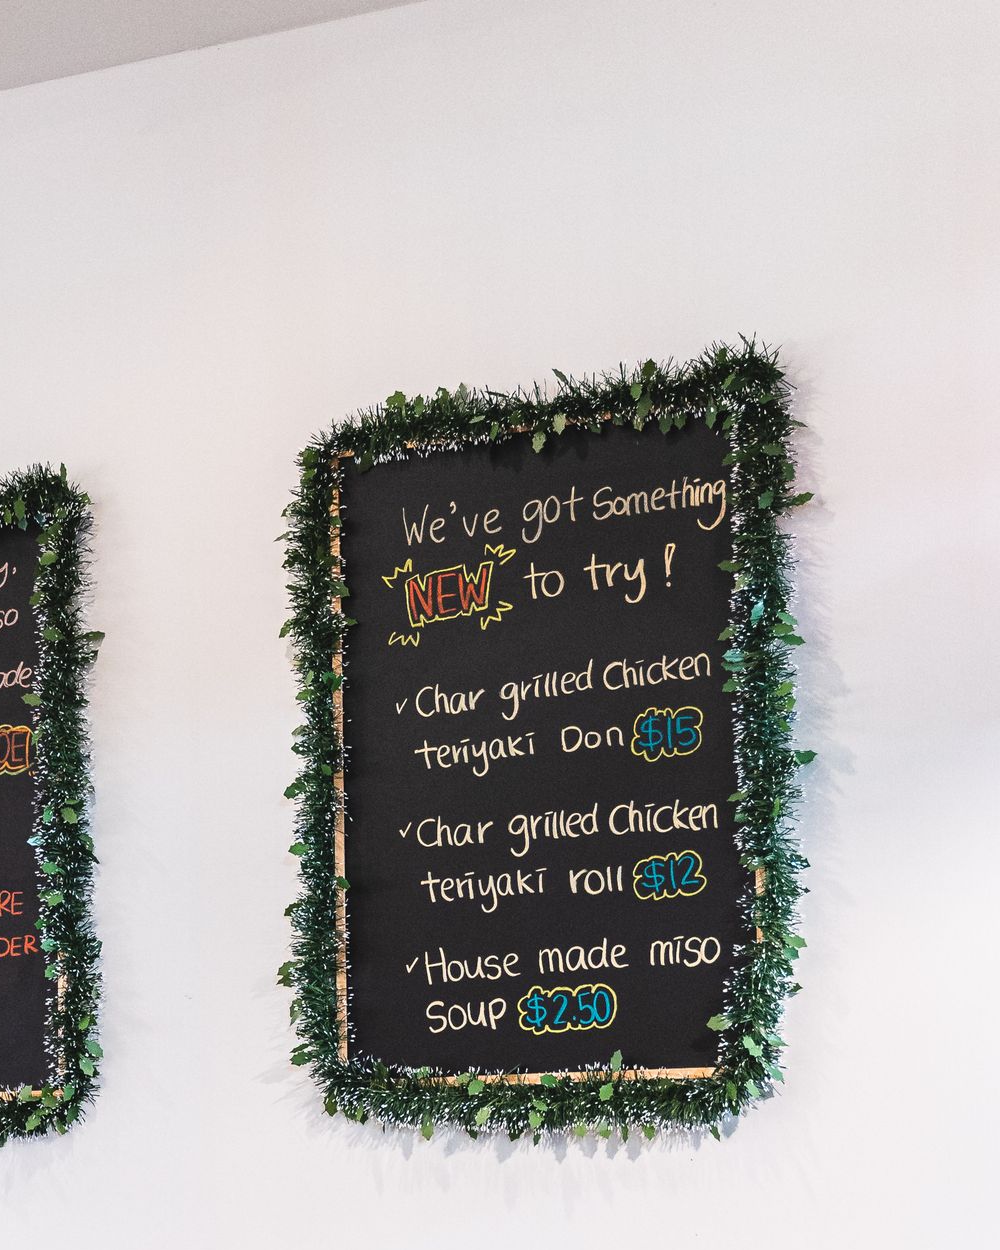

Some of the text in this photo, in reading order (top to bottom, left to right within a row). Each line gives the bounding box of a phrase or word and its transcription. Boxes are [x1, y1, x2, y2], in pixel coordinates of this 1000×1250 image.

[402, 501, 503, 546] We've
[521, 487, 584, 544] got
[407, 563, 490, 621] NEW
[523, 562, 566, 600] to
[415, 652, 711, 721] Char grilled Chicken
[414, 711, 699, 777] teriyaki Don $15
[416, 799, 719, 857] Char grilled Chicken
[420, 857, 702, 914] teriyaki roll $12
[424, 936, 722, 986] House made miso
[525, 990, 614, 1029] $2.50
